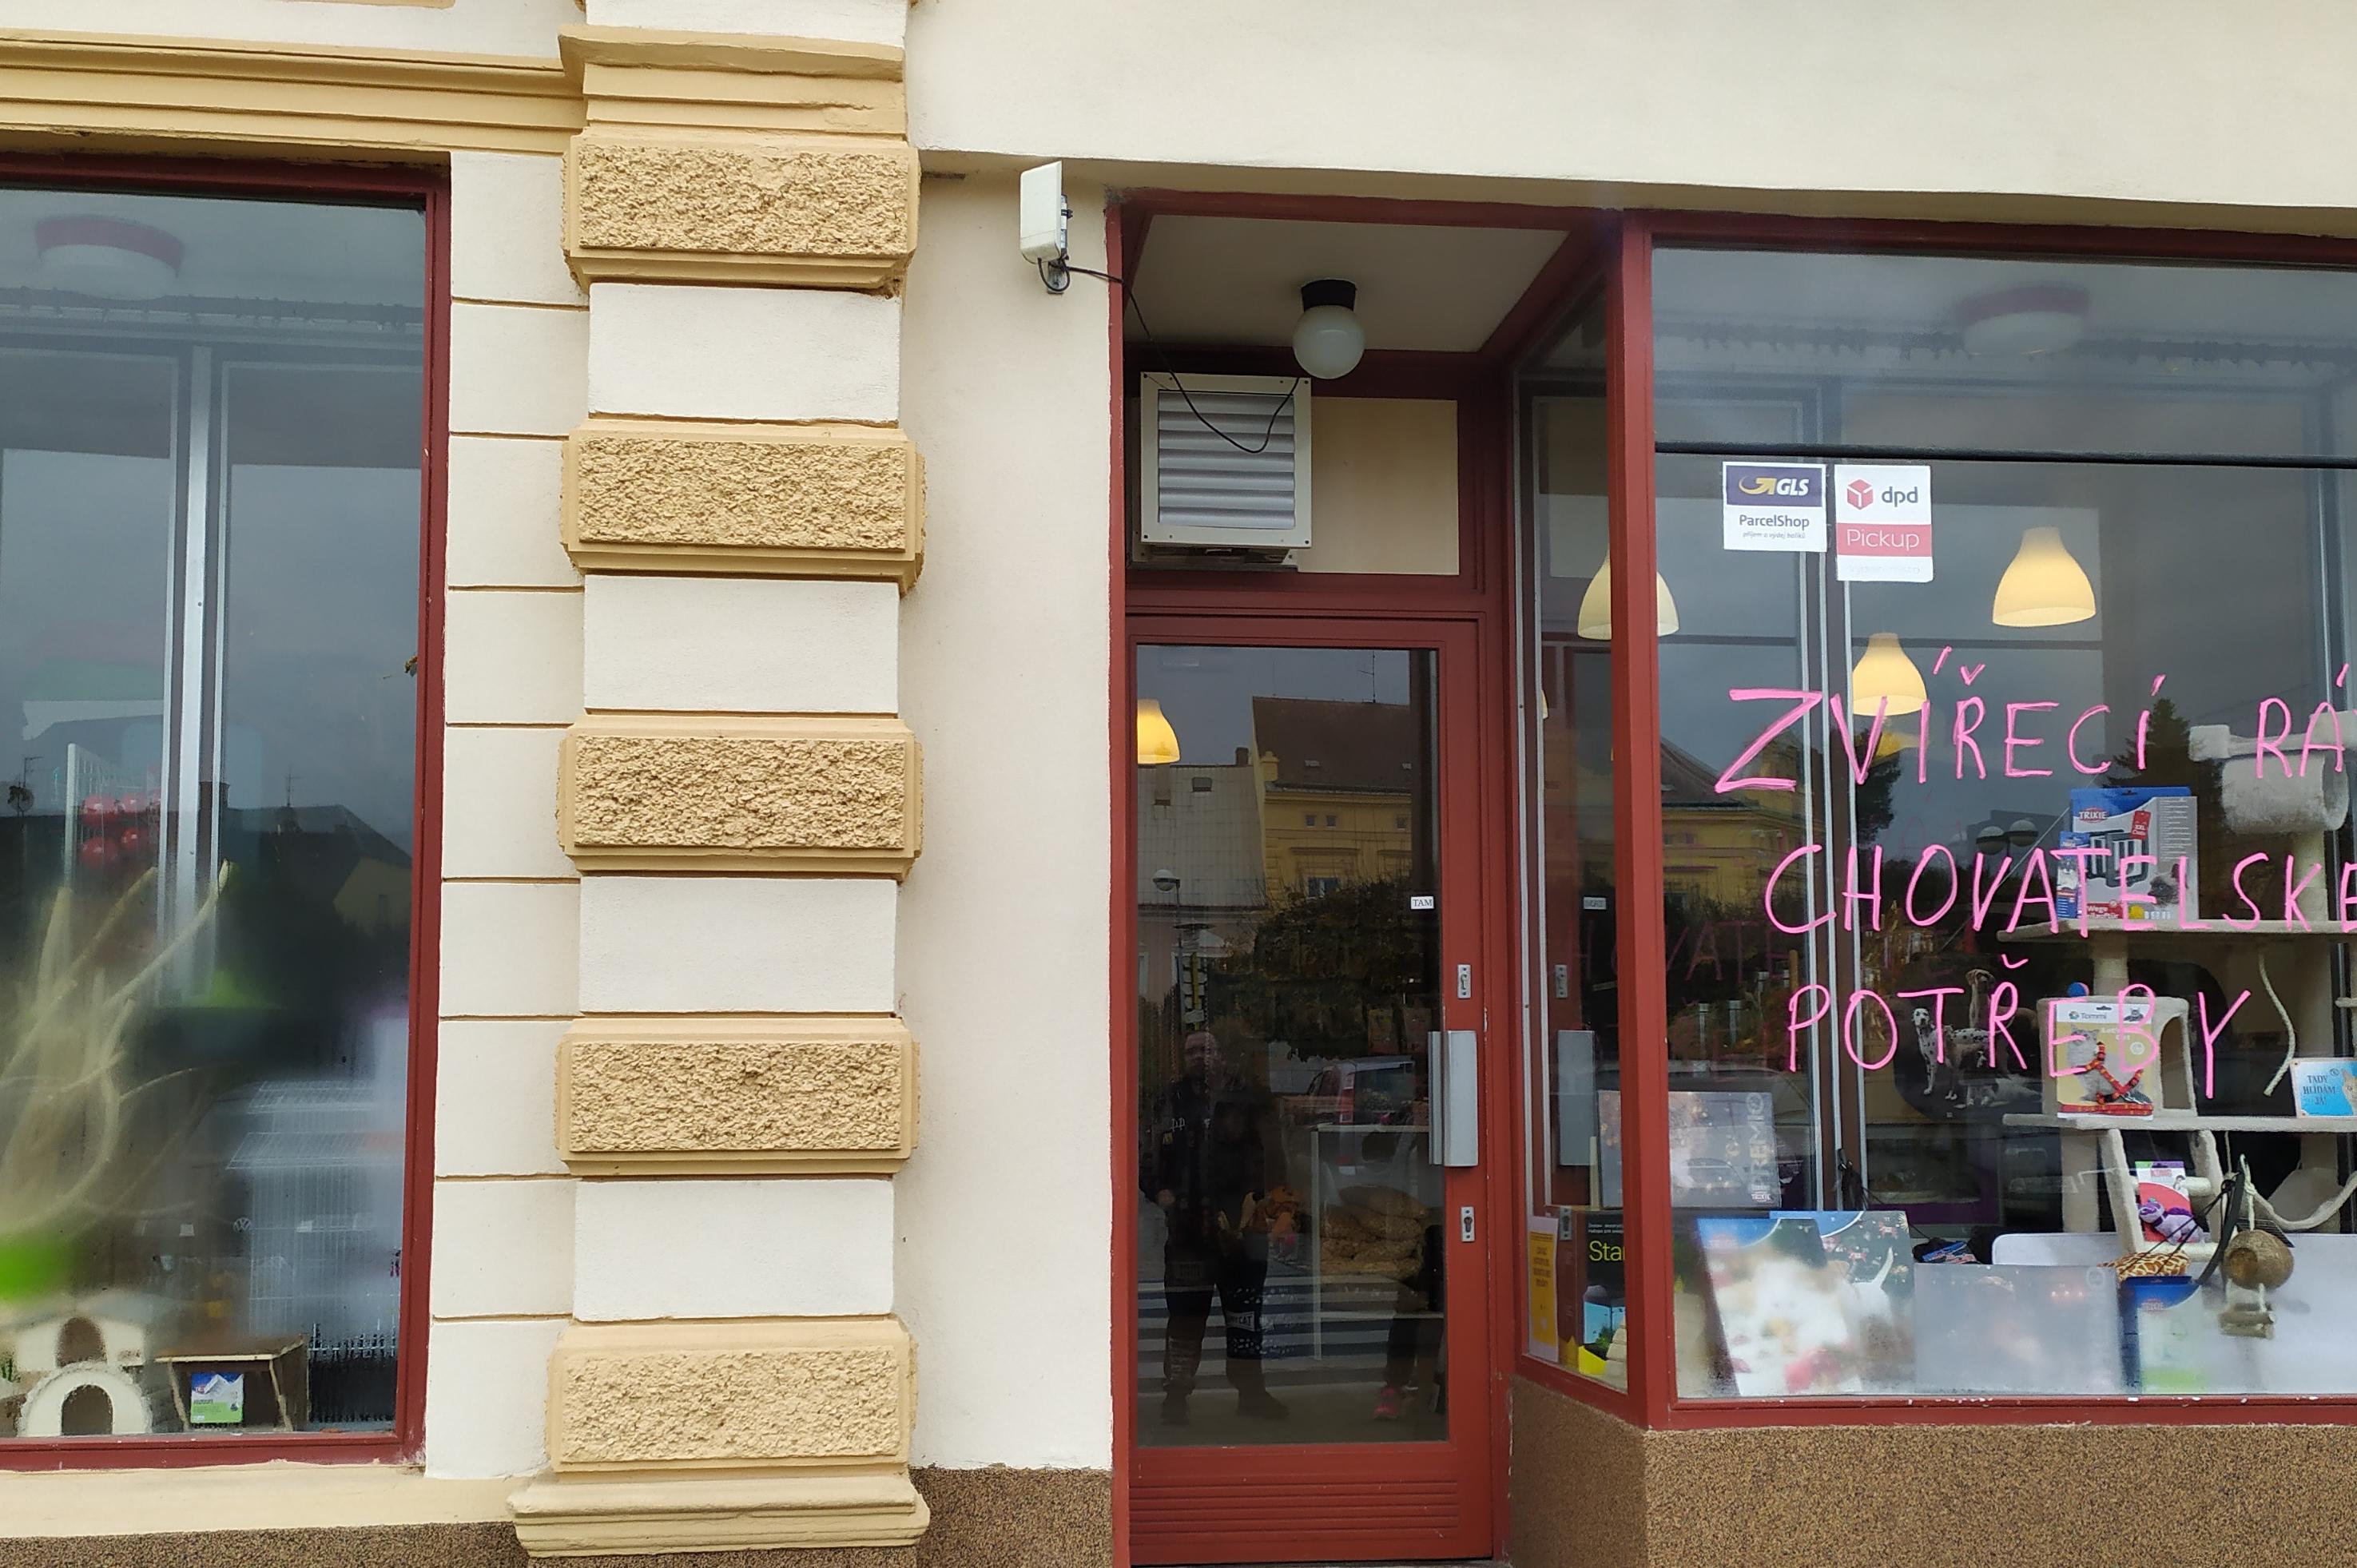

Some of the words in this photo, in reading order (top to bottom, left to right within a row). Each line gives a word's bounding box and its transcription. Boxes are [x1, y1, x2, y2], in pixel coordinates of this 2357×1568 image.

[1776, 478, 1810, 496] GLS
[1882, 486, 1918, 508] dpd
[1739, 514, 1810, 531] ParcelShop
[1846, 528, 1920, 552] Pickup
[1715, 647, 2165, 793] ZVÍŘECÍ
[2256, 664, 2357, 778] RÁ
[2079, 811, 2107, 820] TRIXIE
[1789, 955, 2251, 1099] POTŘEBY
